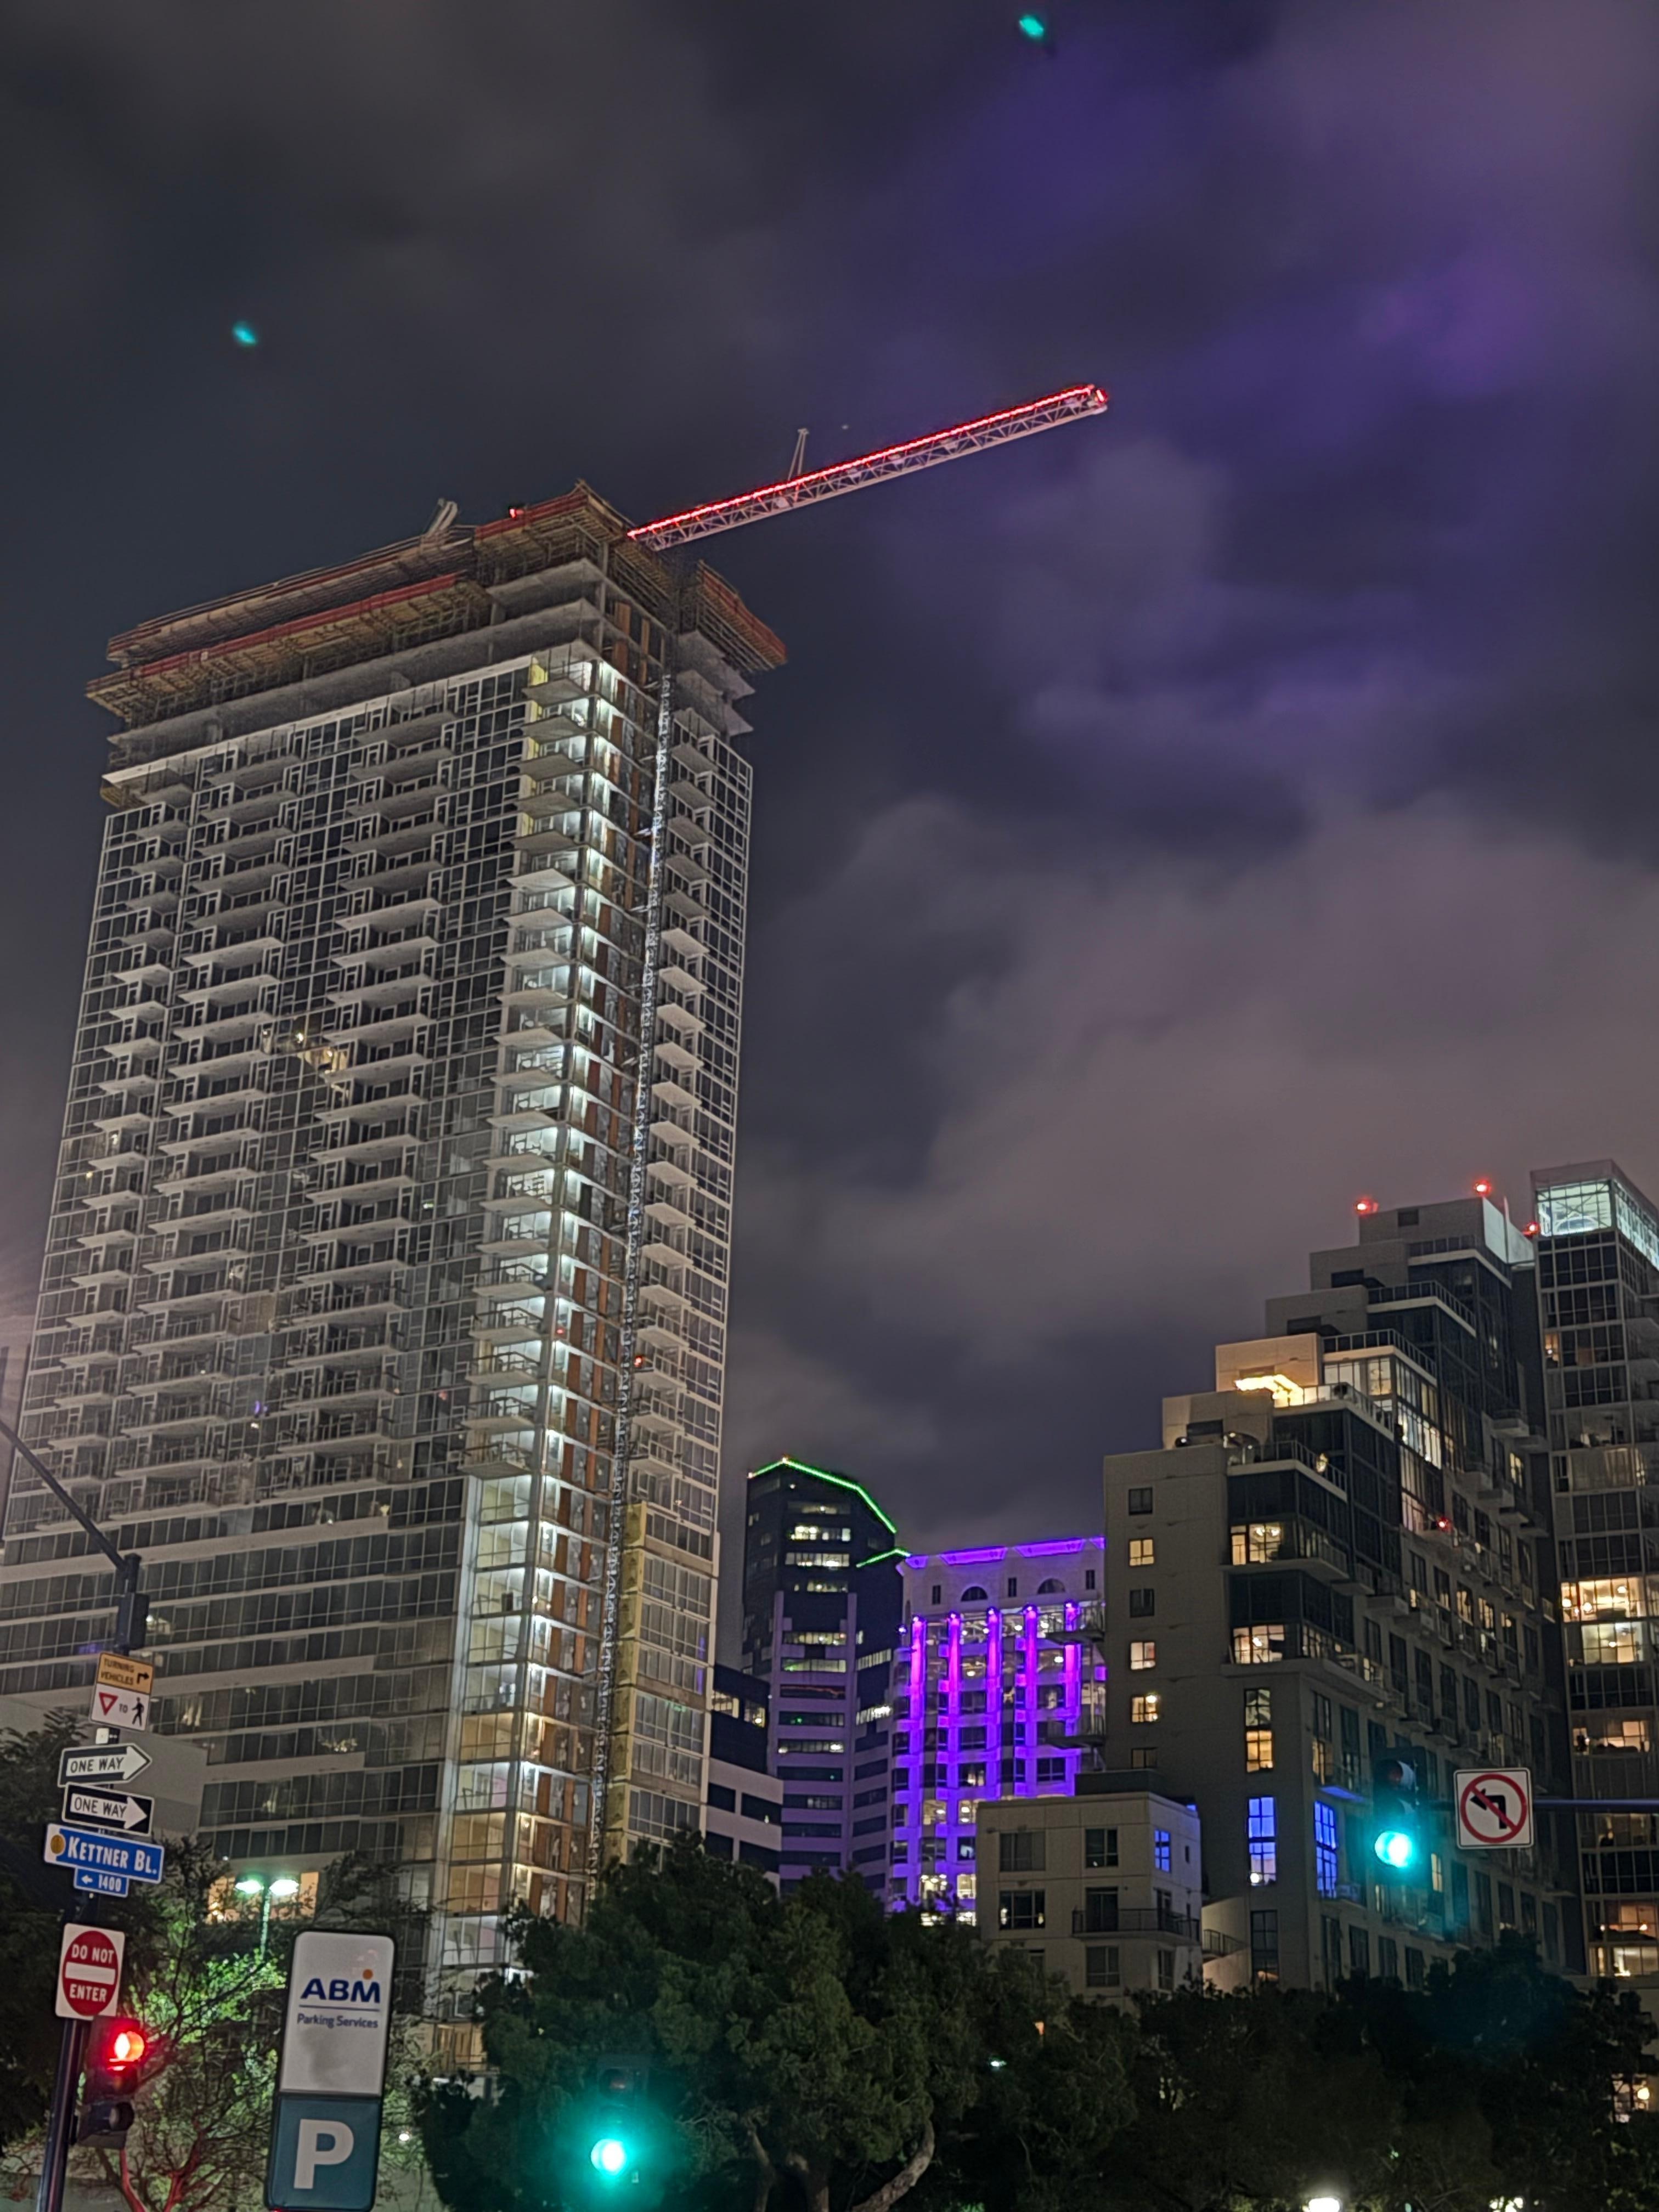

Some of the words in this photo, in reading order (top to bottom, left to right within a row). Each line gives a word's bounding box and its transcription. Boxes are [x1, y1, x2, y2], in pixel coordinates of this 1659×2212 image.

[104, 1658, 134, 1673] TURNING
[100, 1672, 133, 1685] VEHICLES
[119, 1703, 128, 1713] TO
[70, 1759, 94, 1773] ONE
[99, 1757, 125, 1771] WAY
[74, 1797, 98, 1814] ONE
[103, 1802, 127, 1818] WAY
[67, 1836, 129, 1869] KETTNER
[134, 1849, 157, 1875] BL.
[98, 1874, 122, 1892] 1400
[71, 1944, 88, 1960] DO
[92, 1947, 115, 1964] NOT
[70, 1984, 107, 2002] ENTER
[300, 1978, 381, 2004] ABM
[297, 2013, 335, 2029] Parking
[336, 2015, 379, 2029] Services
[293, 2118, 354, 2190] P
